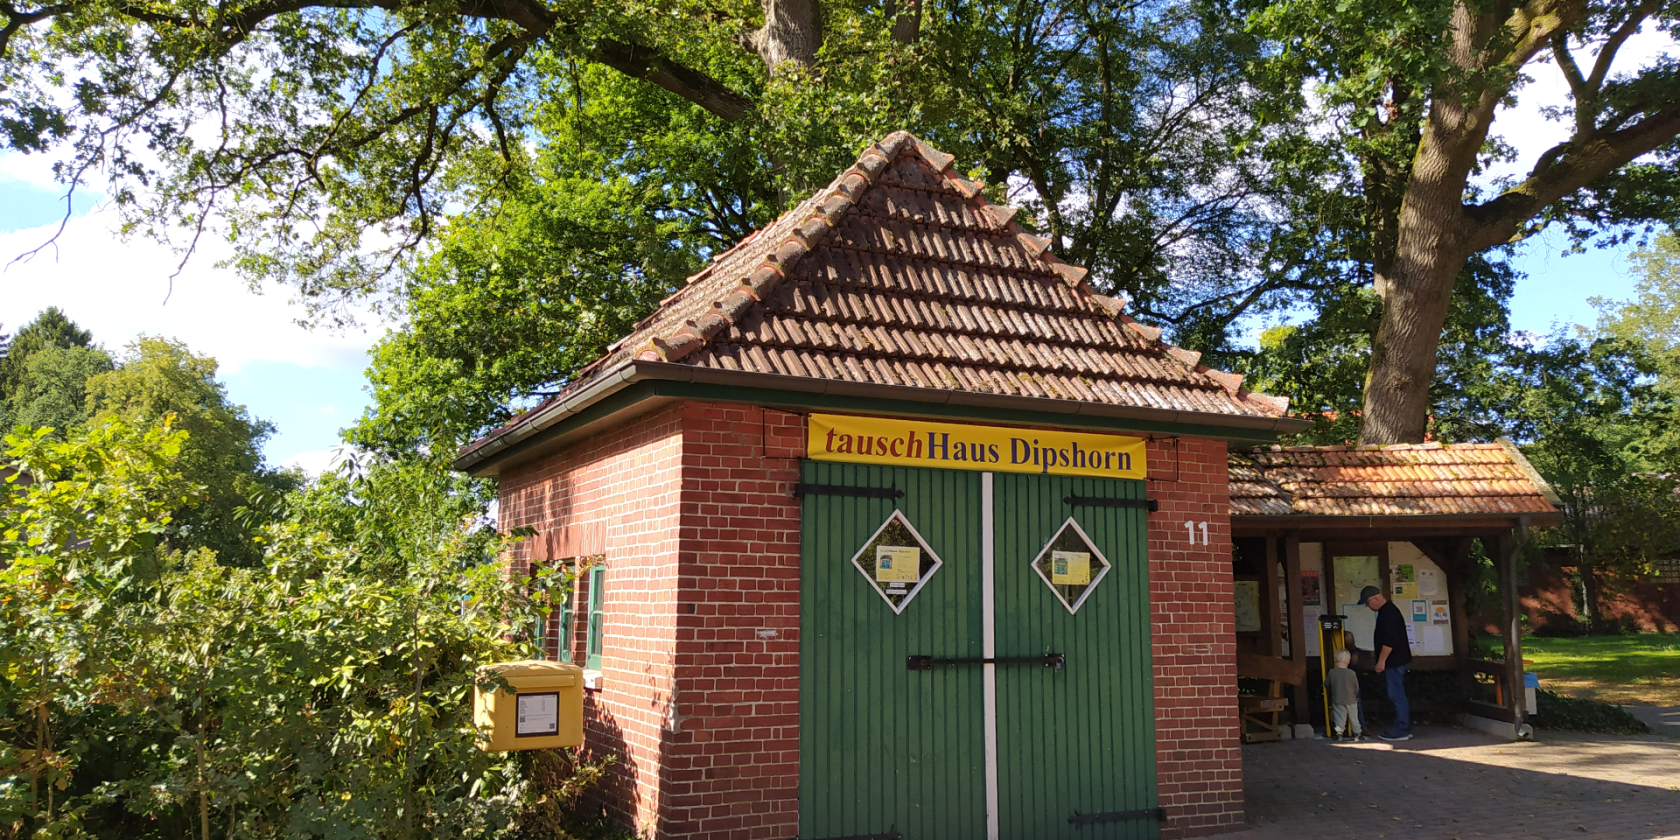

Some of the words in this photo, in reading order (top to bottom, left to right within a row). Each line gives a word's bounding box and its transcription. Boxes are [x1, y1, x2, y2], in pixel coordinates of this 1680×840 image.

[825, 426, 1000, 464] tauschHaus
[1009, 437, 1132, 474] Dipshorn
[1184, 520, 1209, 546] 11
